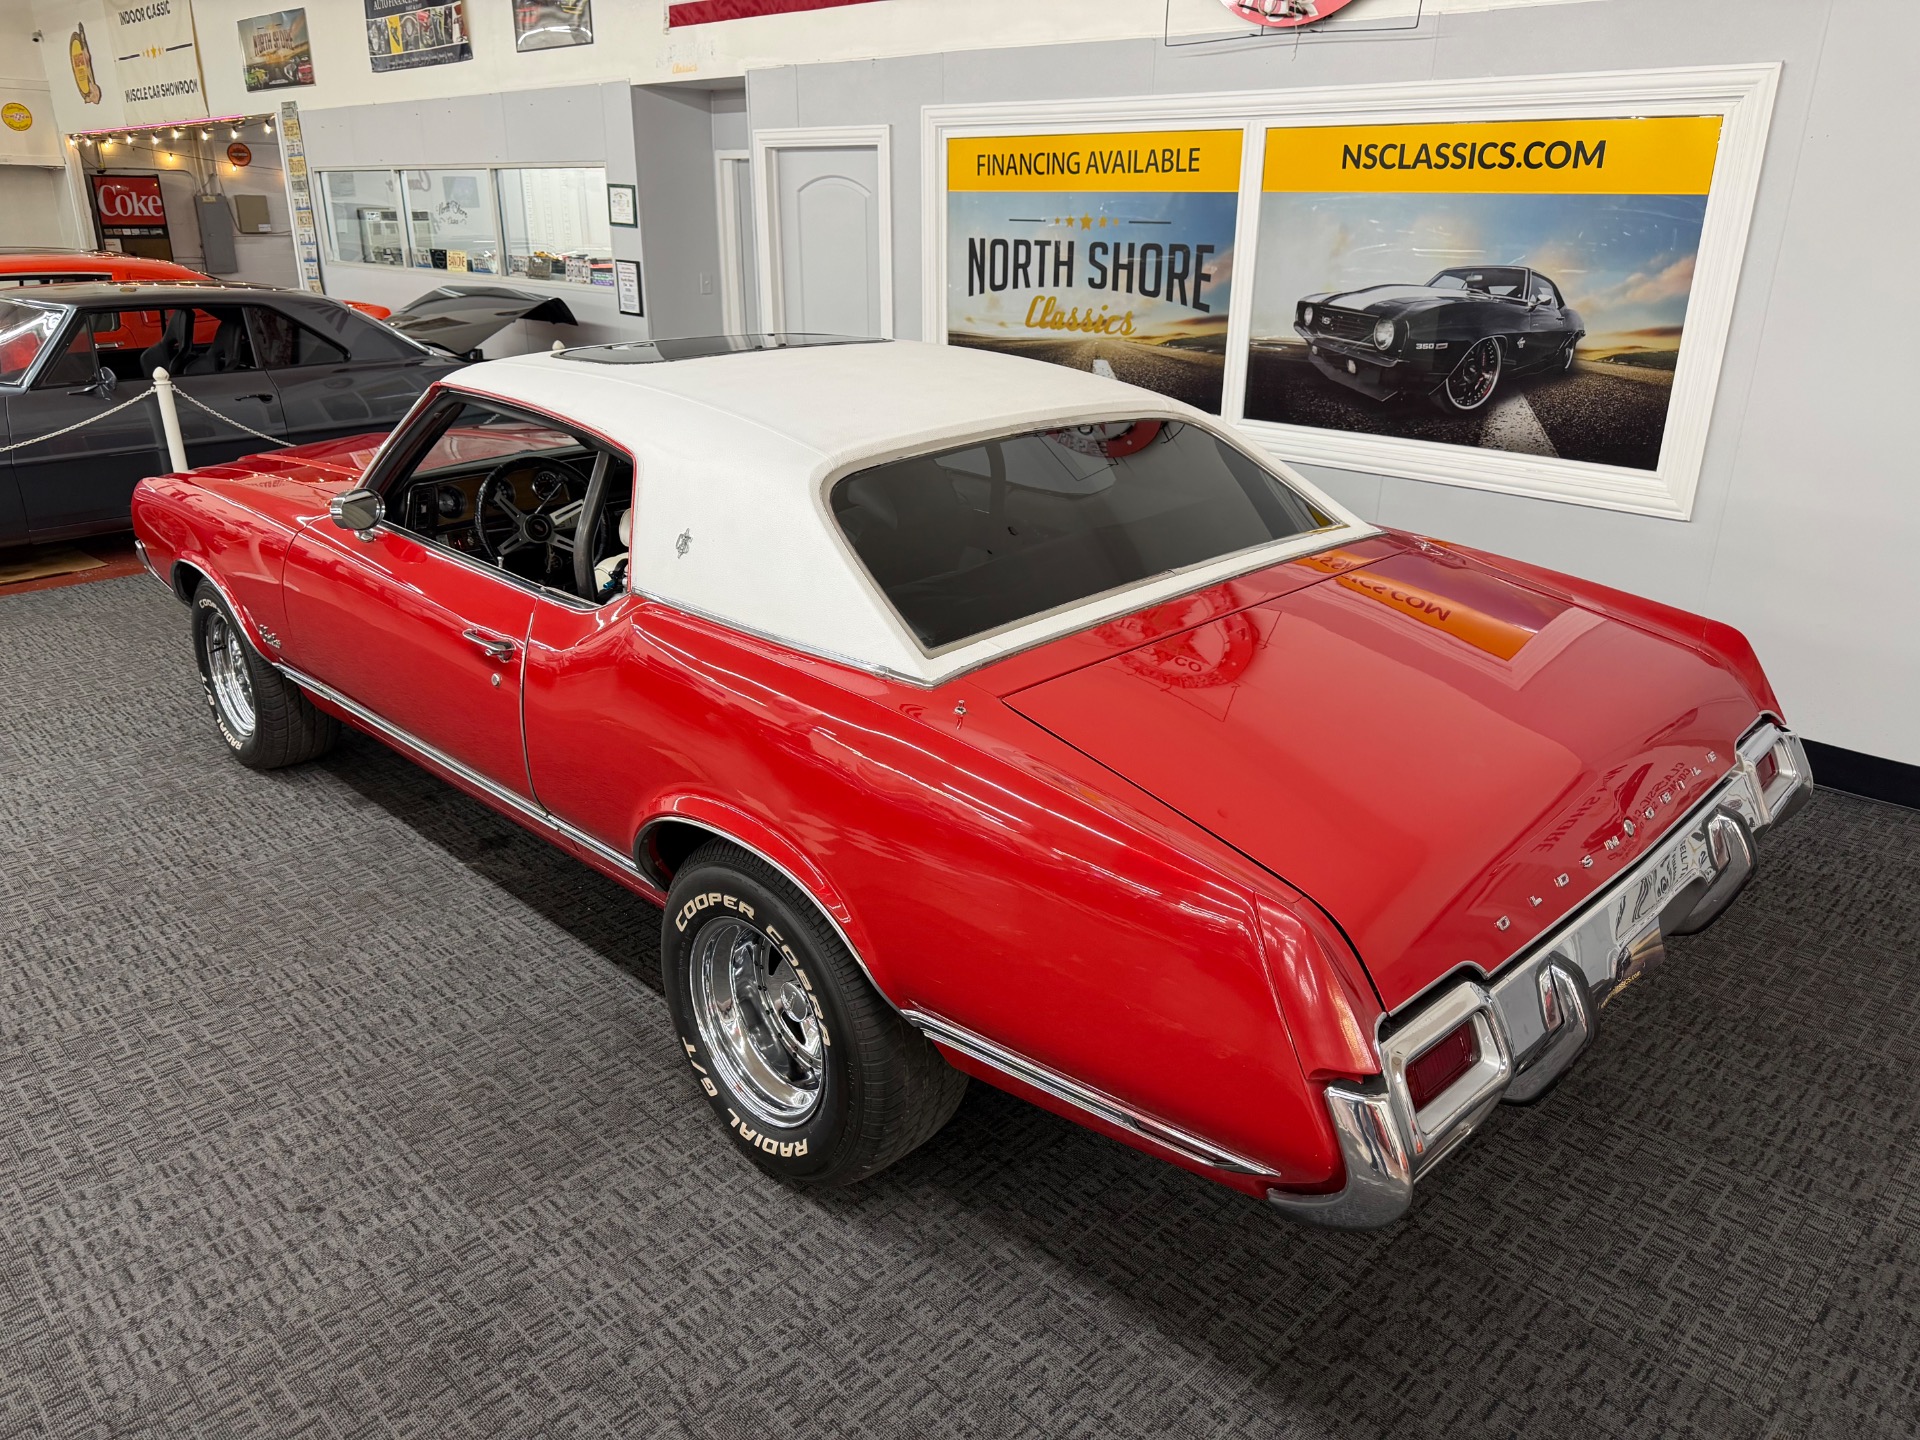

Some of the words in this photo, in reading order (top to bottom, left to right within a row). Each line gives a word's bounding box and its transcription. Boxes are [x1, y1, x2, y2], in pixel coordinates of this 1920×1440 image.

[118, 7, 146, 26] INDOOR
[146, 0, 171, 20] CLASSIC
[124, 86, 148, 103] MUSCLE
[148, 84, 161, 99] CAR
[160, 78, 199, 97] SHOWROOM
[976, 151, 1081, 177] FINANCING
[1085, 147, 1201, 175] AVAILABLE
[1340, 139, 1607, 170] NSCLASSICS.COM
[97, 184, 164, 217] Coke
[967, 237, 1075, 298] NORTH
[1087, 241, 1216, 315] SHORE
[1024, 294, 1137, 336] Classics
[1415, 342, 1435, 350] 350
[674, 892, 756, 933] COOPER
[765, 923, 832, 1047] COBRA
[681, 1036, 719, 1098] G/T
[727, 1107, 809, 1158] RADIAL
